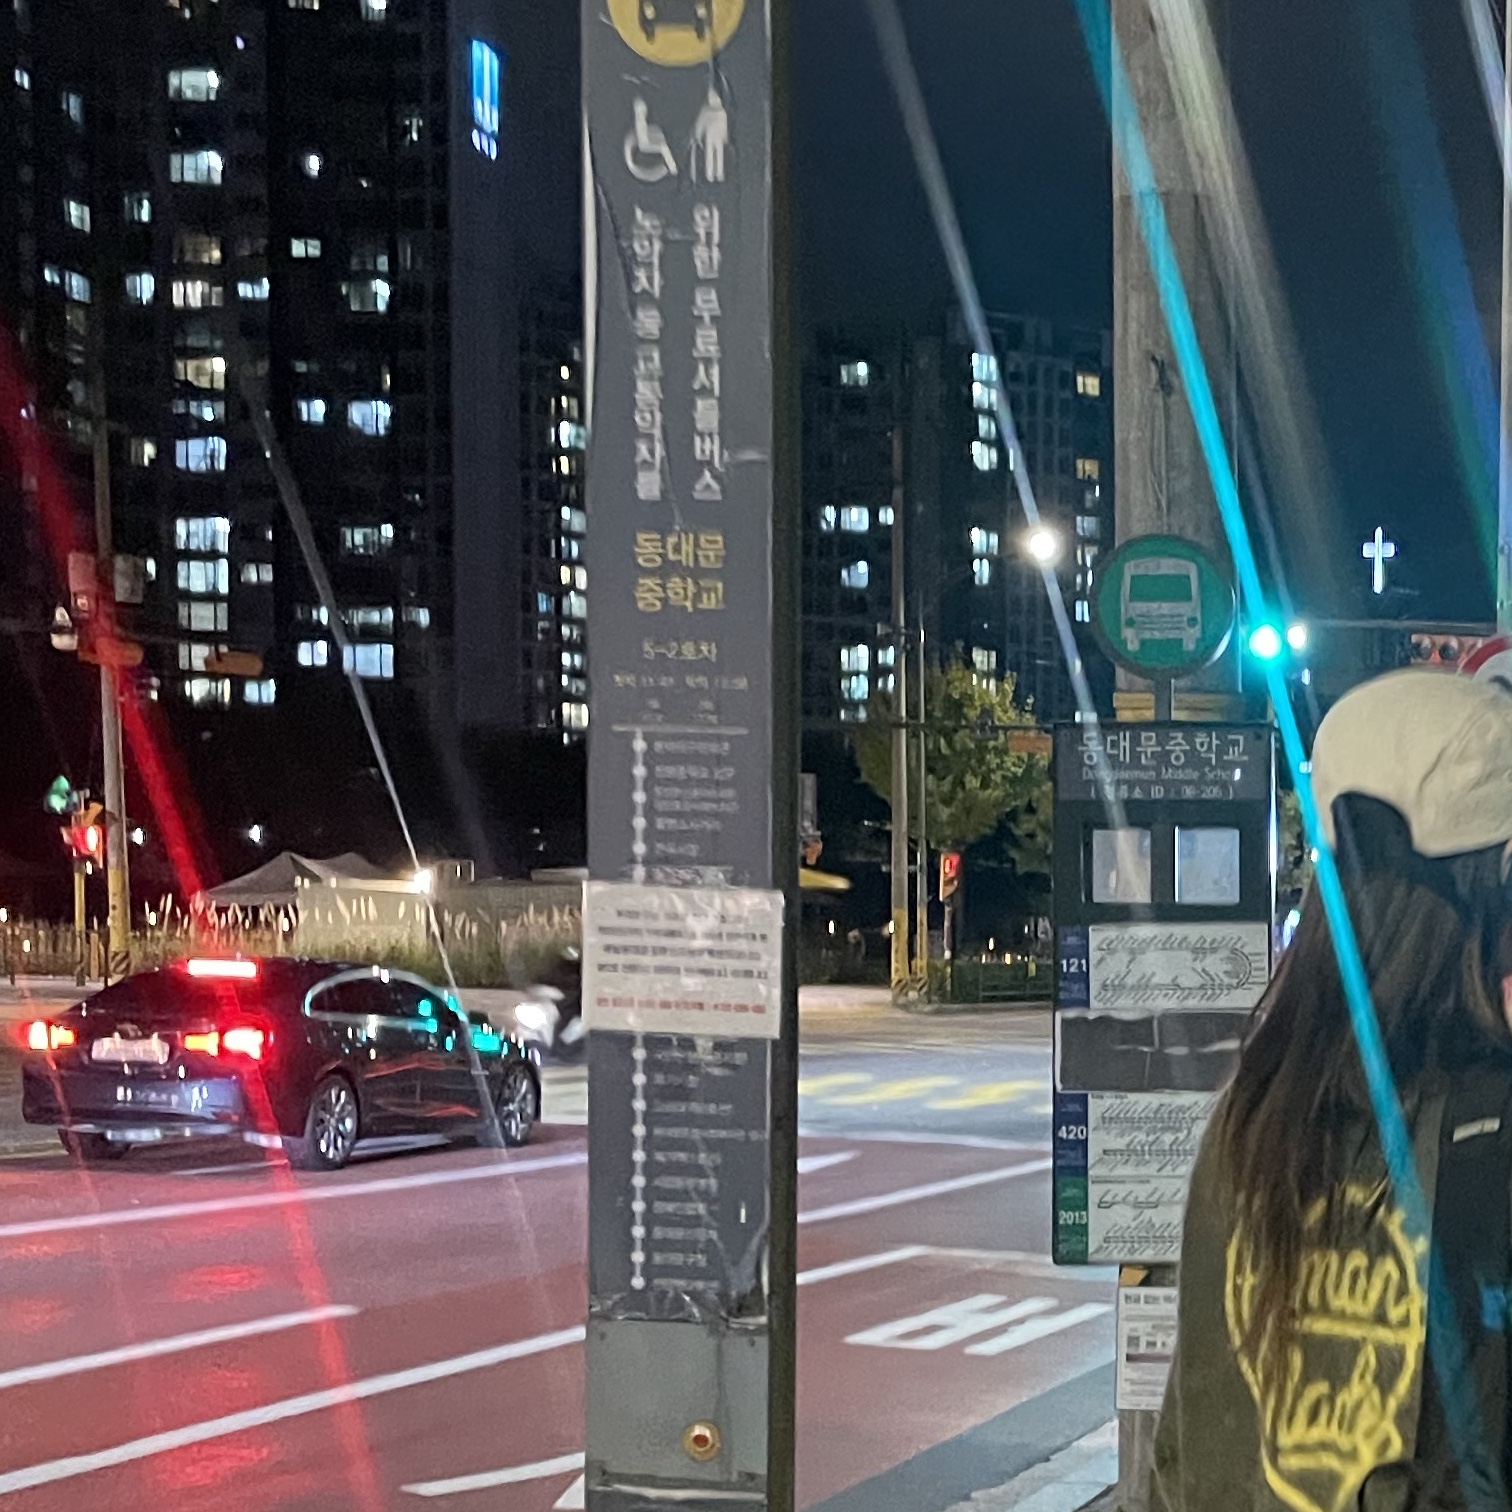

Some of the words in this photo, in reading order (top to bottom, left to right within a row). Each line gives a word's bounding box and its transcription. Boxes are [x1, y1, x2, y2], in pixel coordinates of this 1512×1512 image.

[692, 203, 720, 279] 위한
[692, 287, 723, 500] 무료셔틀버스
[634, 528, 726, 568] 동대문
[634, 575, 726, 613] 중학교
[1077, 731, 1249, 766] 동대문중학교
[1060, 958, 1087, 973] 121
[1057, 1126, 1087, 1140] 420
[1058, 1211, 1088, 1225] 2013
